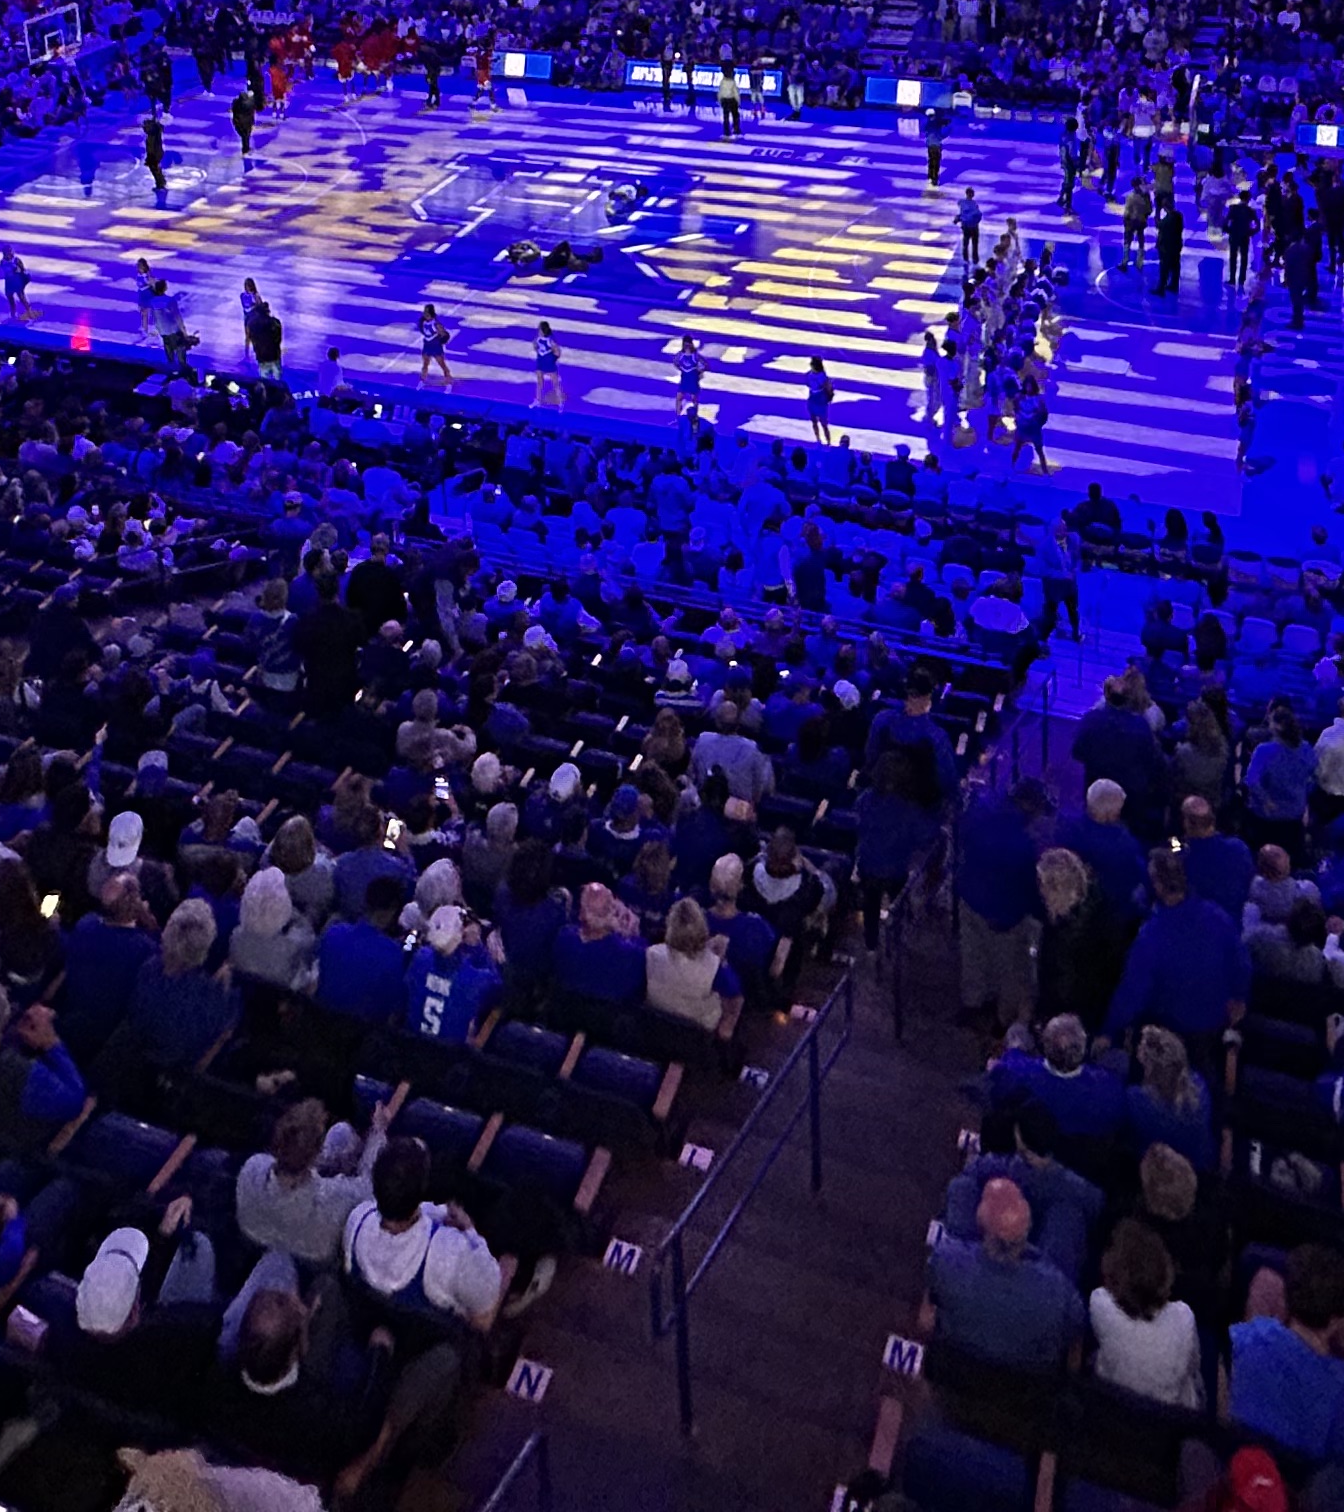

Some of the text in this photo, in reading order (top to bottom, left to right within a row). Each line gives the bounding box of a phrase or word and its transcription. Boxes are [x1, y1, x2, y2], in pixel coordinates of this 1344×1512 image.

[420, 996, 444, 1035] 5
[609, 1244, 636, 1269] M
[889, 1342, 917, 1370] M
[516, 1366, 544, 1395] N
